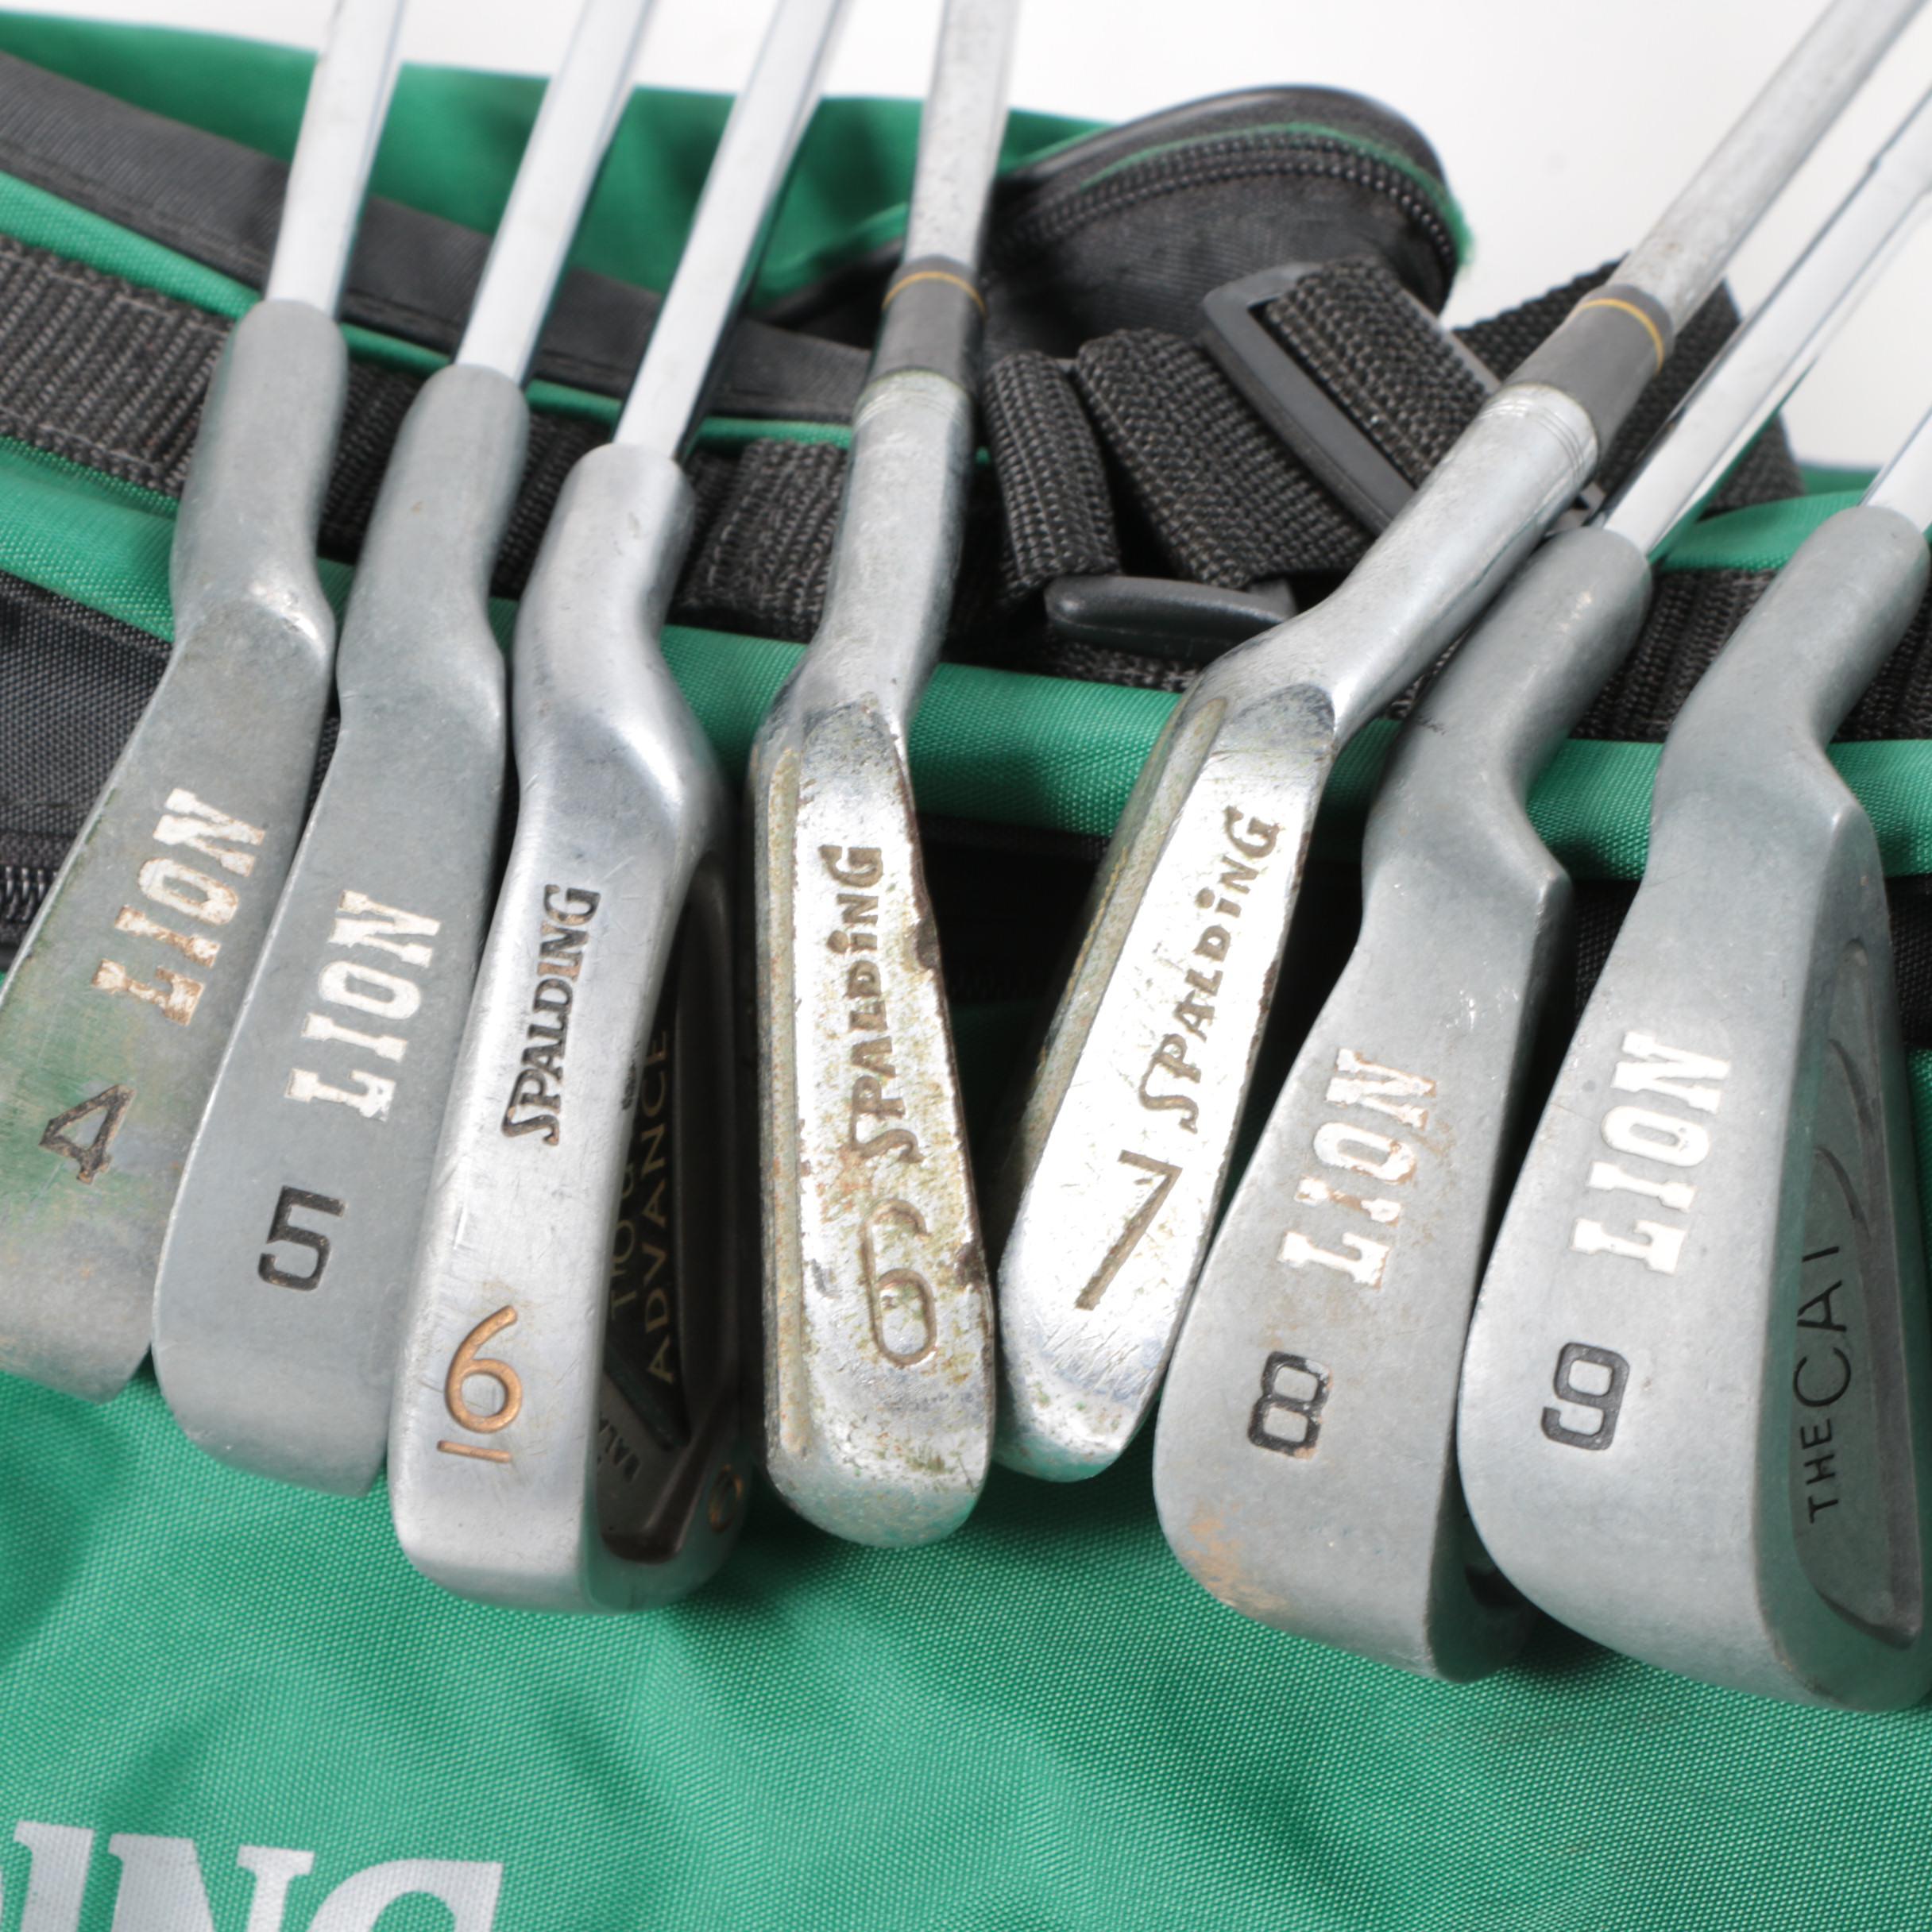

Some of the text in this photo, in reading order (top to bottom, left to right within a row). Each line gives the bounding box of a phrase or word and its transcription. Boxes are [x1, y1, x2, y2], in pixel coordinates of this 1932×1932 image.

[93, 788, 265, 1026] LION
[284, 890, 441, 1122] LION
[500, 884, 601, 1146] SPALDING
[40, 1084, 136, 1184] 4
[641, 1029, 675, 1385] ADVANCE
[1075, 1149, 1184, 1311] 7
[1277, 1048, 1438, 1290] LION
[1571, 1030, 1732, 1274] LION
[257, 1184, 347, 1292] 5
[860, 1199, 939, 1368] 6
[1246, 1350, 1334, 1460] 8
[1540, 1339, 1631, 1451] 9
